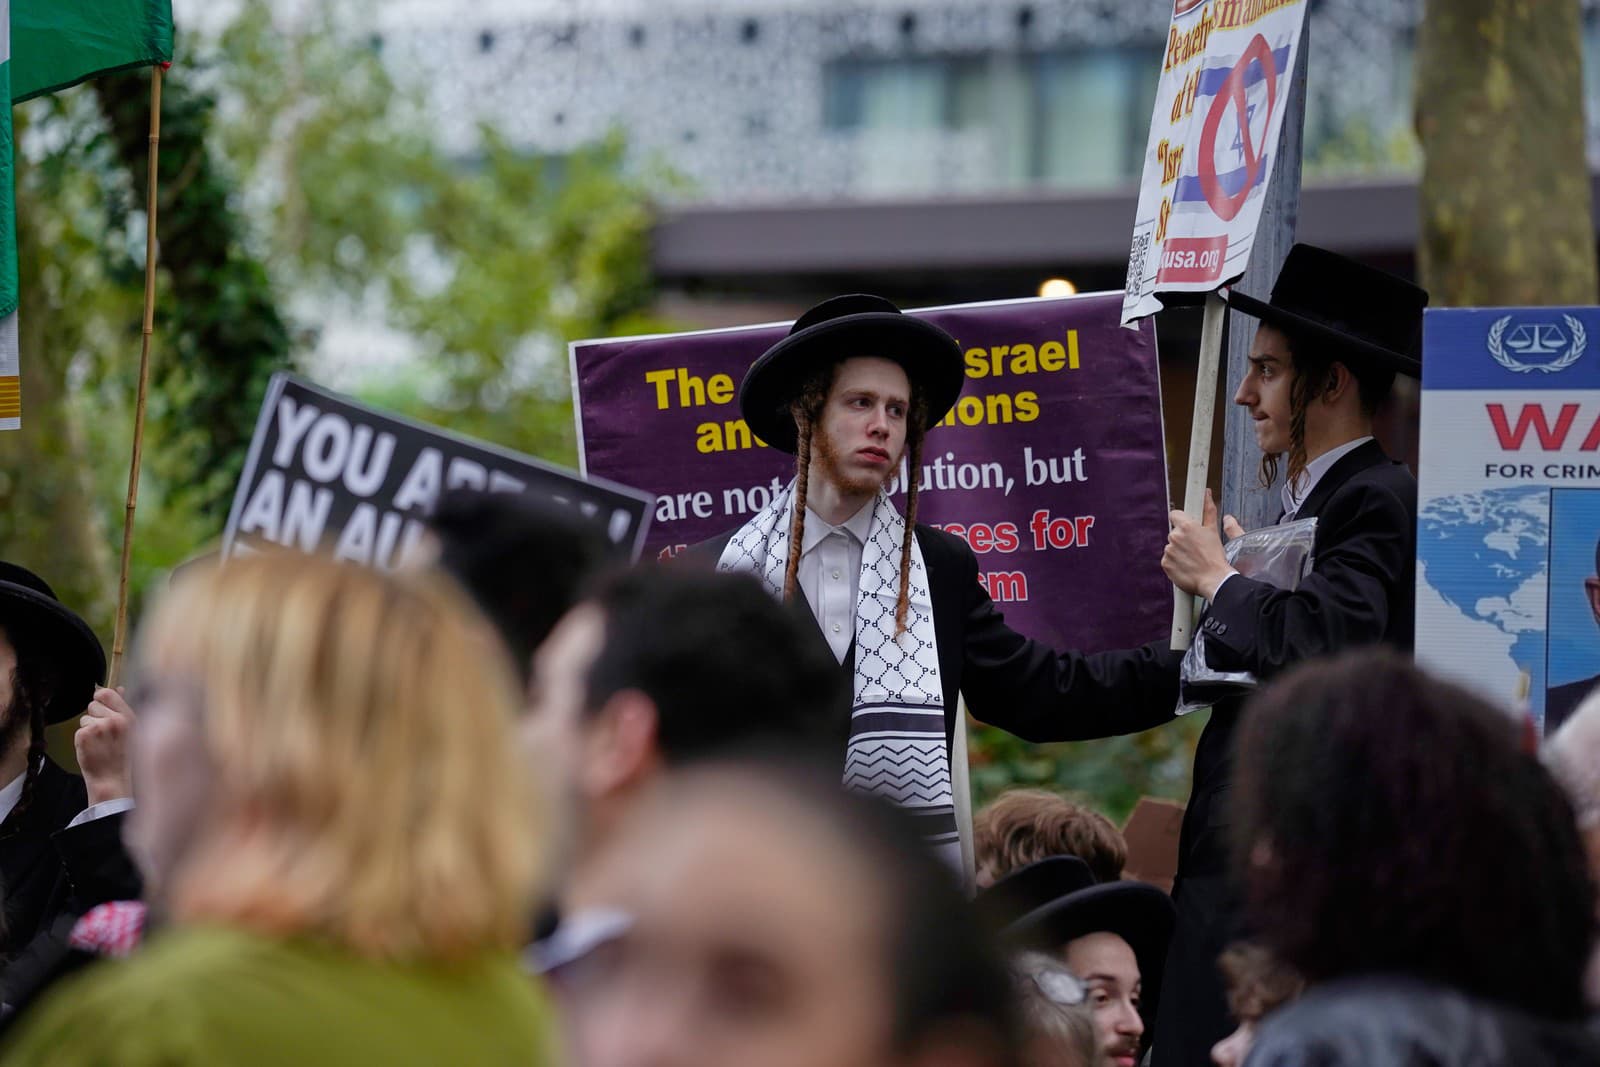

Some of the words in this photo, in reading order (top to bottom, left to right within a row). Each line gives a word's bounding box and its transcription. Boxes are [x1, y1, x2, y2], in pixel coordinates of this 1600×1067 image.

[645, 367, 735, 410] The
[955, 329, 1081, 379] srael
[270, 394, 398, 499] YOU
[696, 418, 769, 454] an
[1484, 463, 1535, 479] FOR
[239, 470, 335, 555] AN
[655, 490, 713, 523] are
[723, 475, 784, 516] not
[884, 451, 1015, 497] olution,
[1023, 446, 1089, 487] but
[1031, 508, 1095, 551] for
